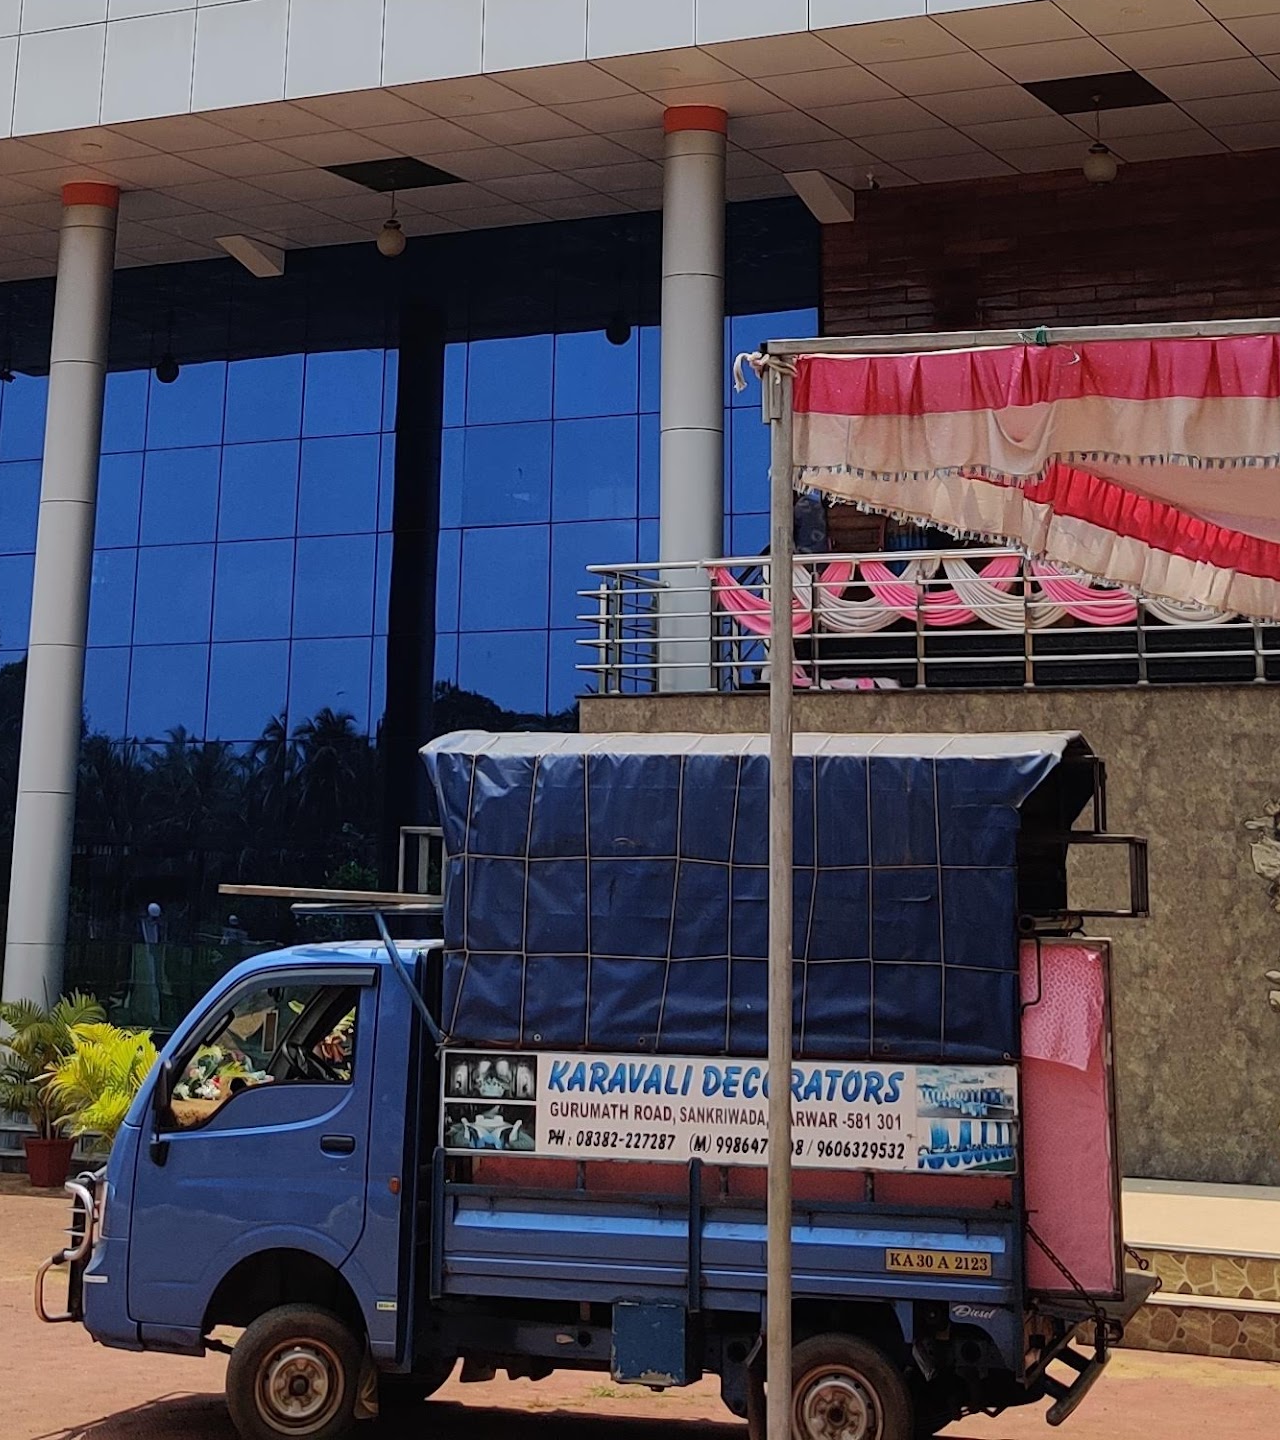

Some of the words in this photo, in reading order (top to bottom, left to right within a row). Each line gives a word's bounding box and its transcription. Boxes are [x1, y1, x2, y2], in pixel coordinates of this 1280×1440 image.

[548, 1060, 694, 1096] KARAVALI
[549, 1101, 630, 1122] GURUMATH
[633, 1106, 677, 1126] ROAD,
[679, 1106, 769, 1130] SANKRIWADA,
[791, 1110, 838, 1129] RWAR
[877, 1113, 902, 1131] 301
[576, 1130, 676, 1151] 08382-227287
[689, 1132, 712, 1154] (M)
[716, 1135, 804, 1157] 9986478
[816, 1139, 905, 1160] 9606329532
[937, 1255, 949, 1269] A
[954, 1256, 988, 1271] 2123
[952, 1304, 996, 1319] Diesel
